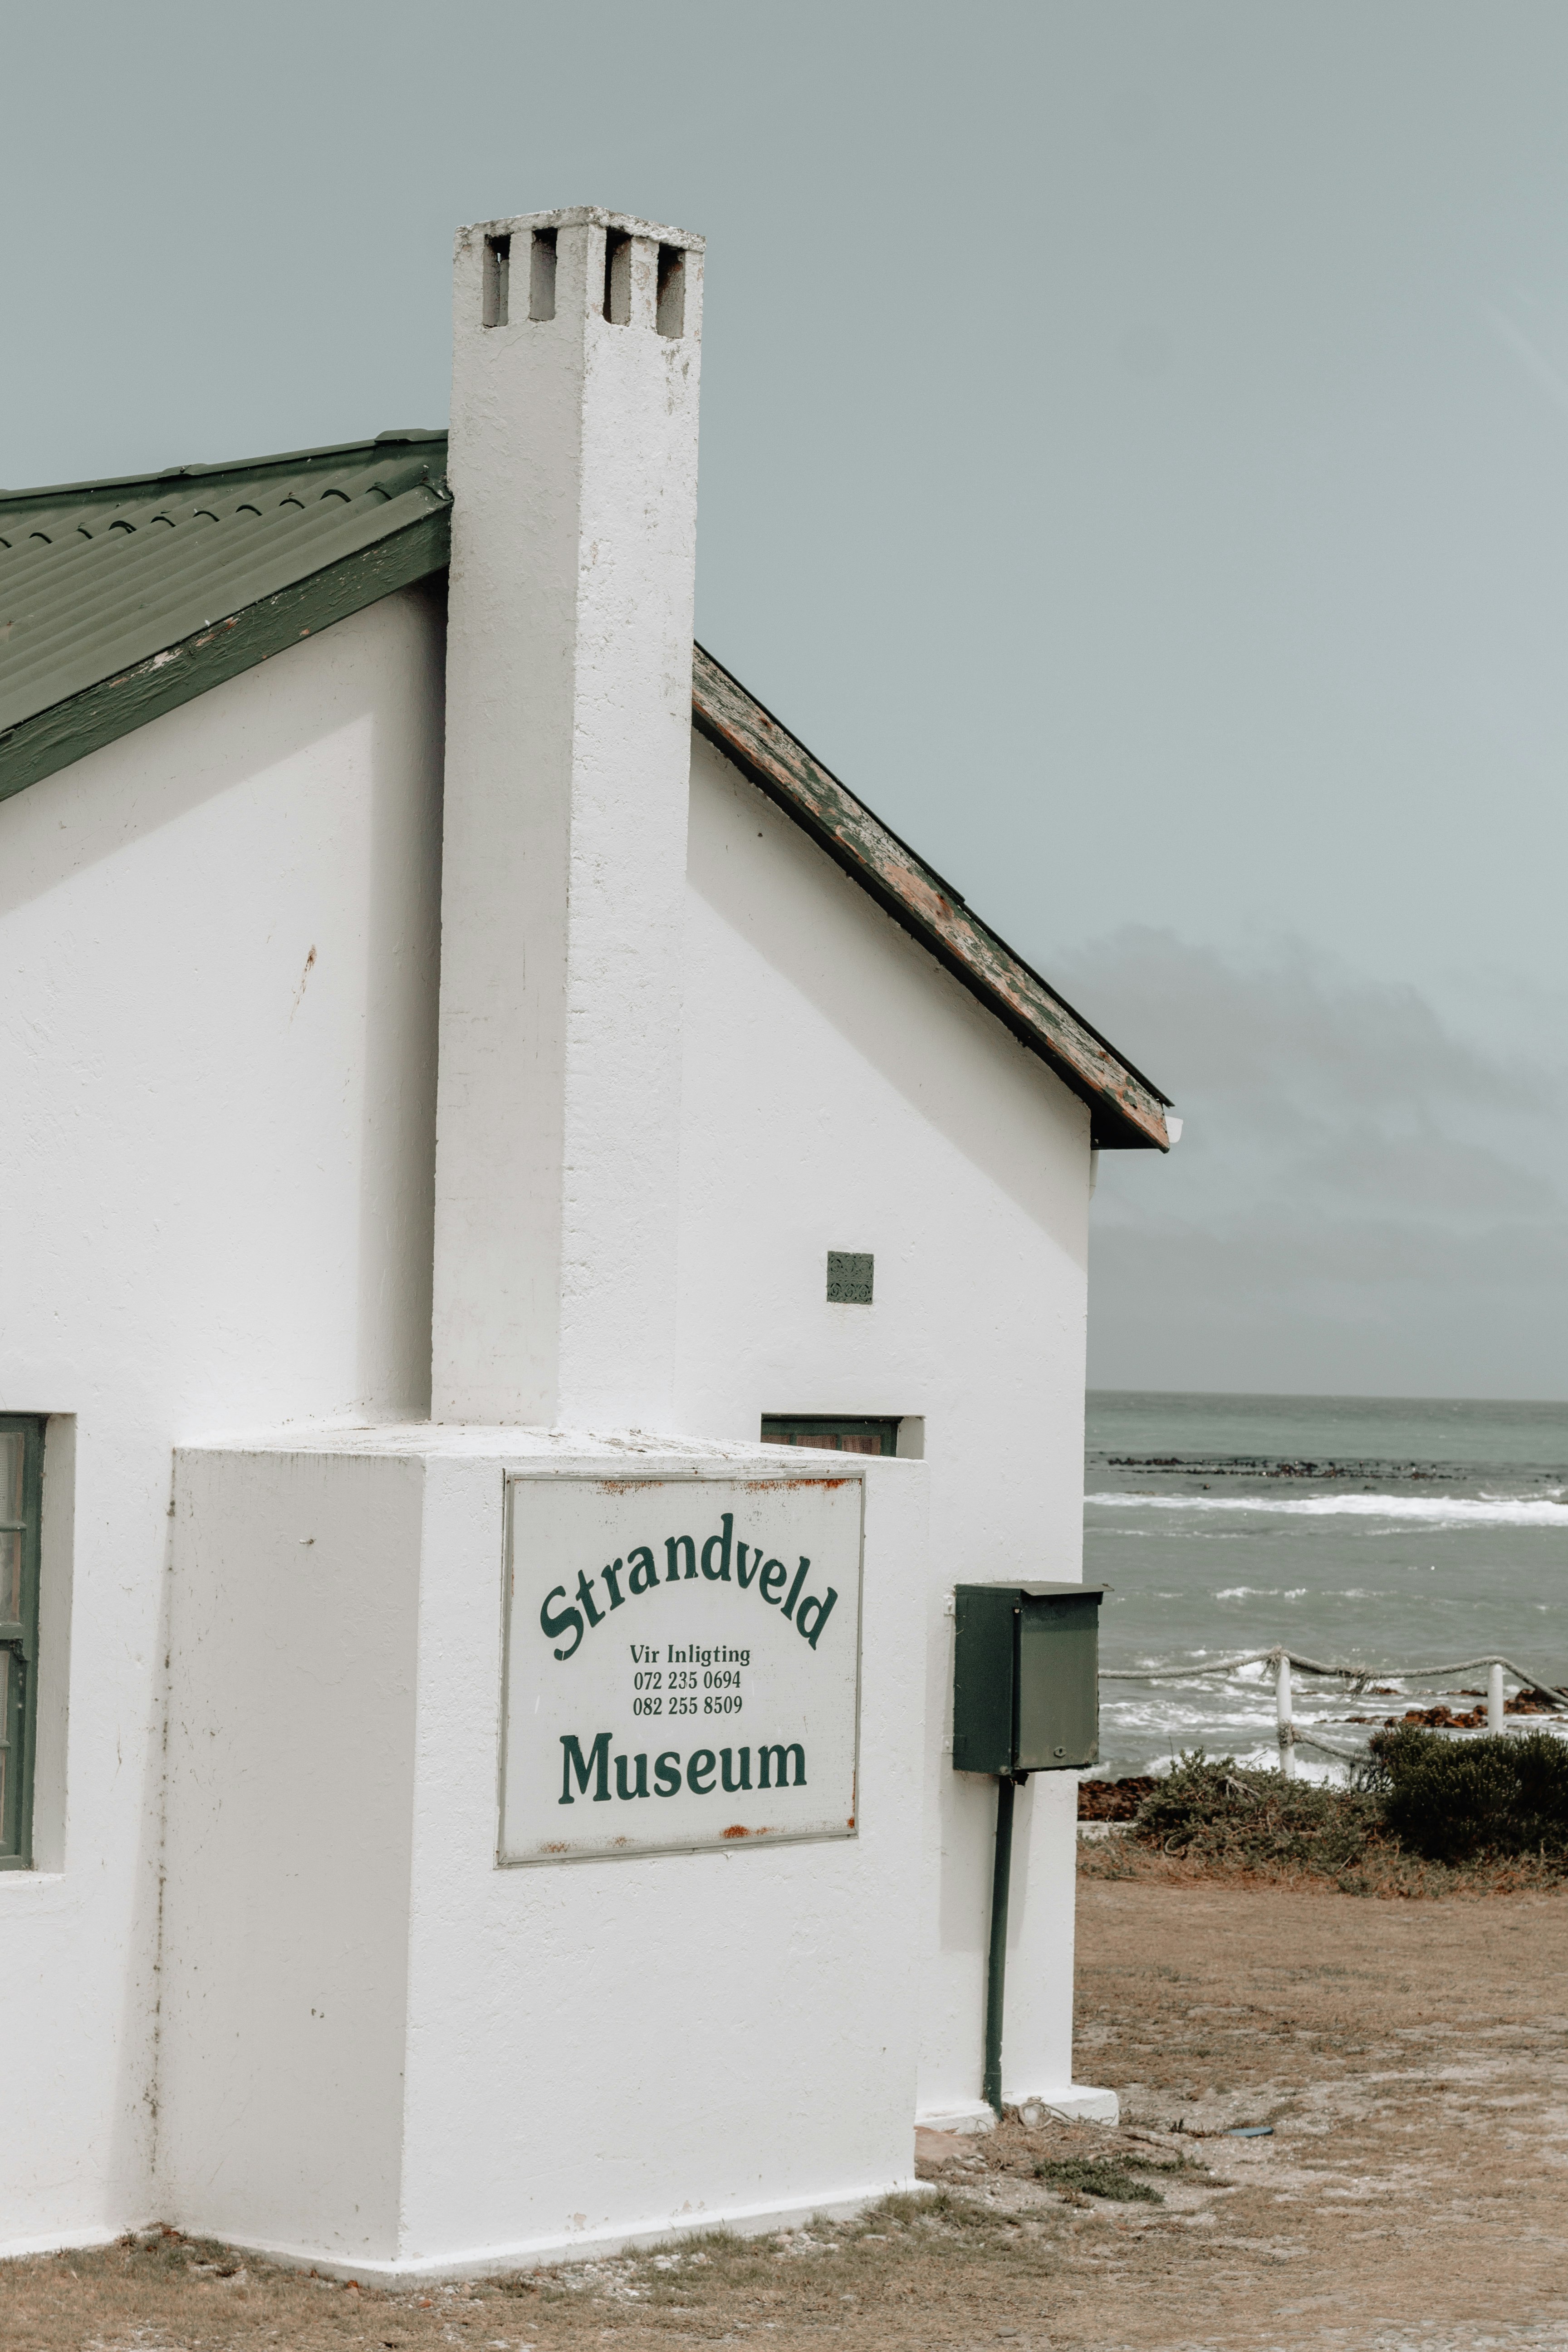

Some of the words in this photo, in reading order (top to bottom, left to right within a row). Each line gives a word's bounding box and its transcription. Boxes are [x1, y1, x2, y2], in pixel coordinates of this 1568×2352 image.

[540, 1513, 838, 1661] Strandveld
[630, 1645, 660, 1663] Vir
[667, 1644, 750, 1667] Inligting
[634, 1672, 662, 1690] 072
[668, 1671, 697, 1689] 235
[704, 1671, 740, 1689] 0694
[633, 1697, 662, 1716] 082
[668, 1697, 697, 1715] 255
[704, 1695, 742, 1714] 8509
[558, 1732, 807, 1805] Museum
